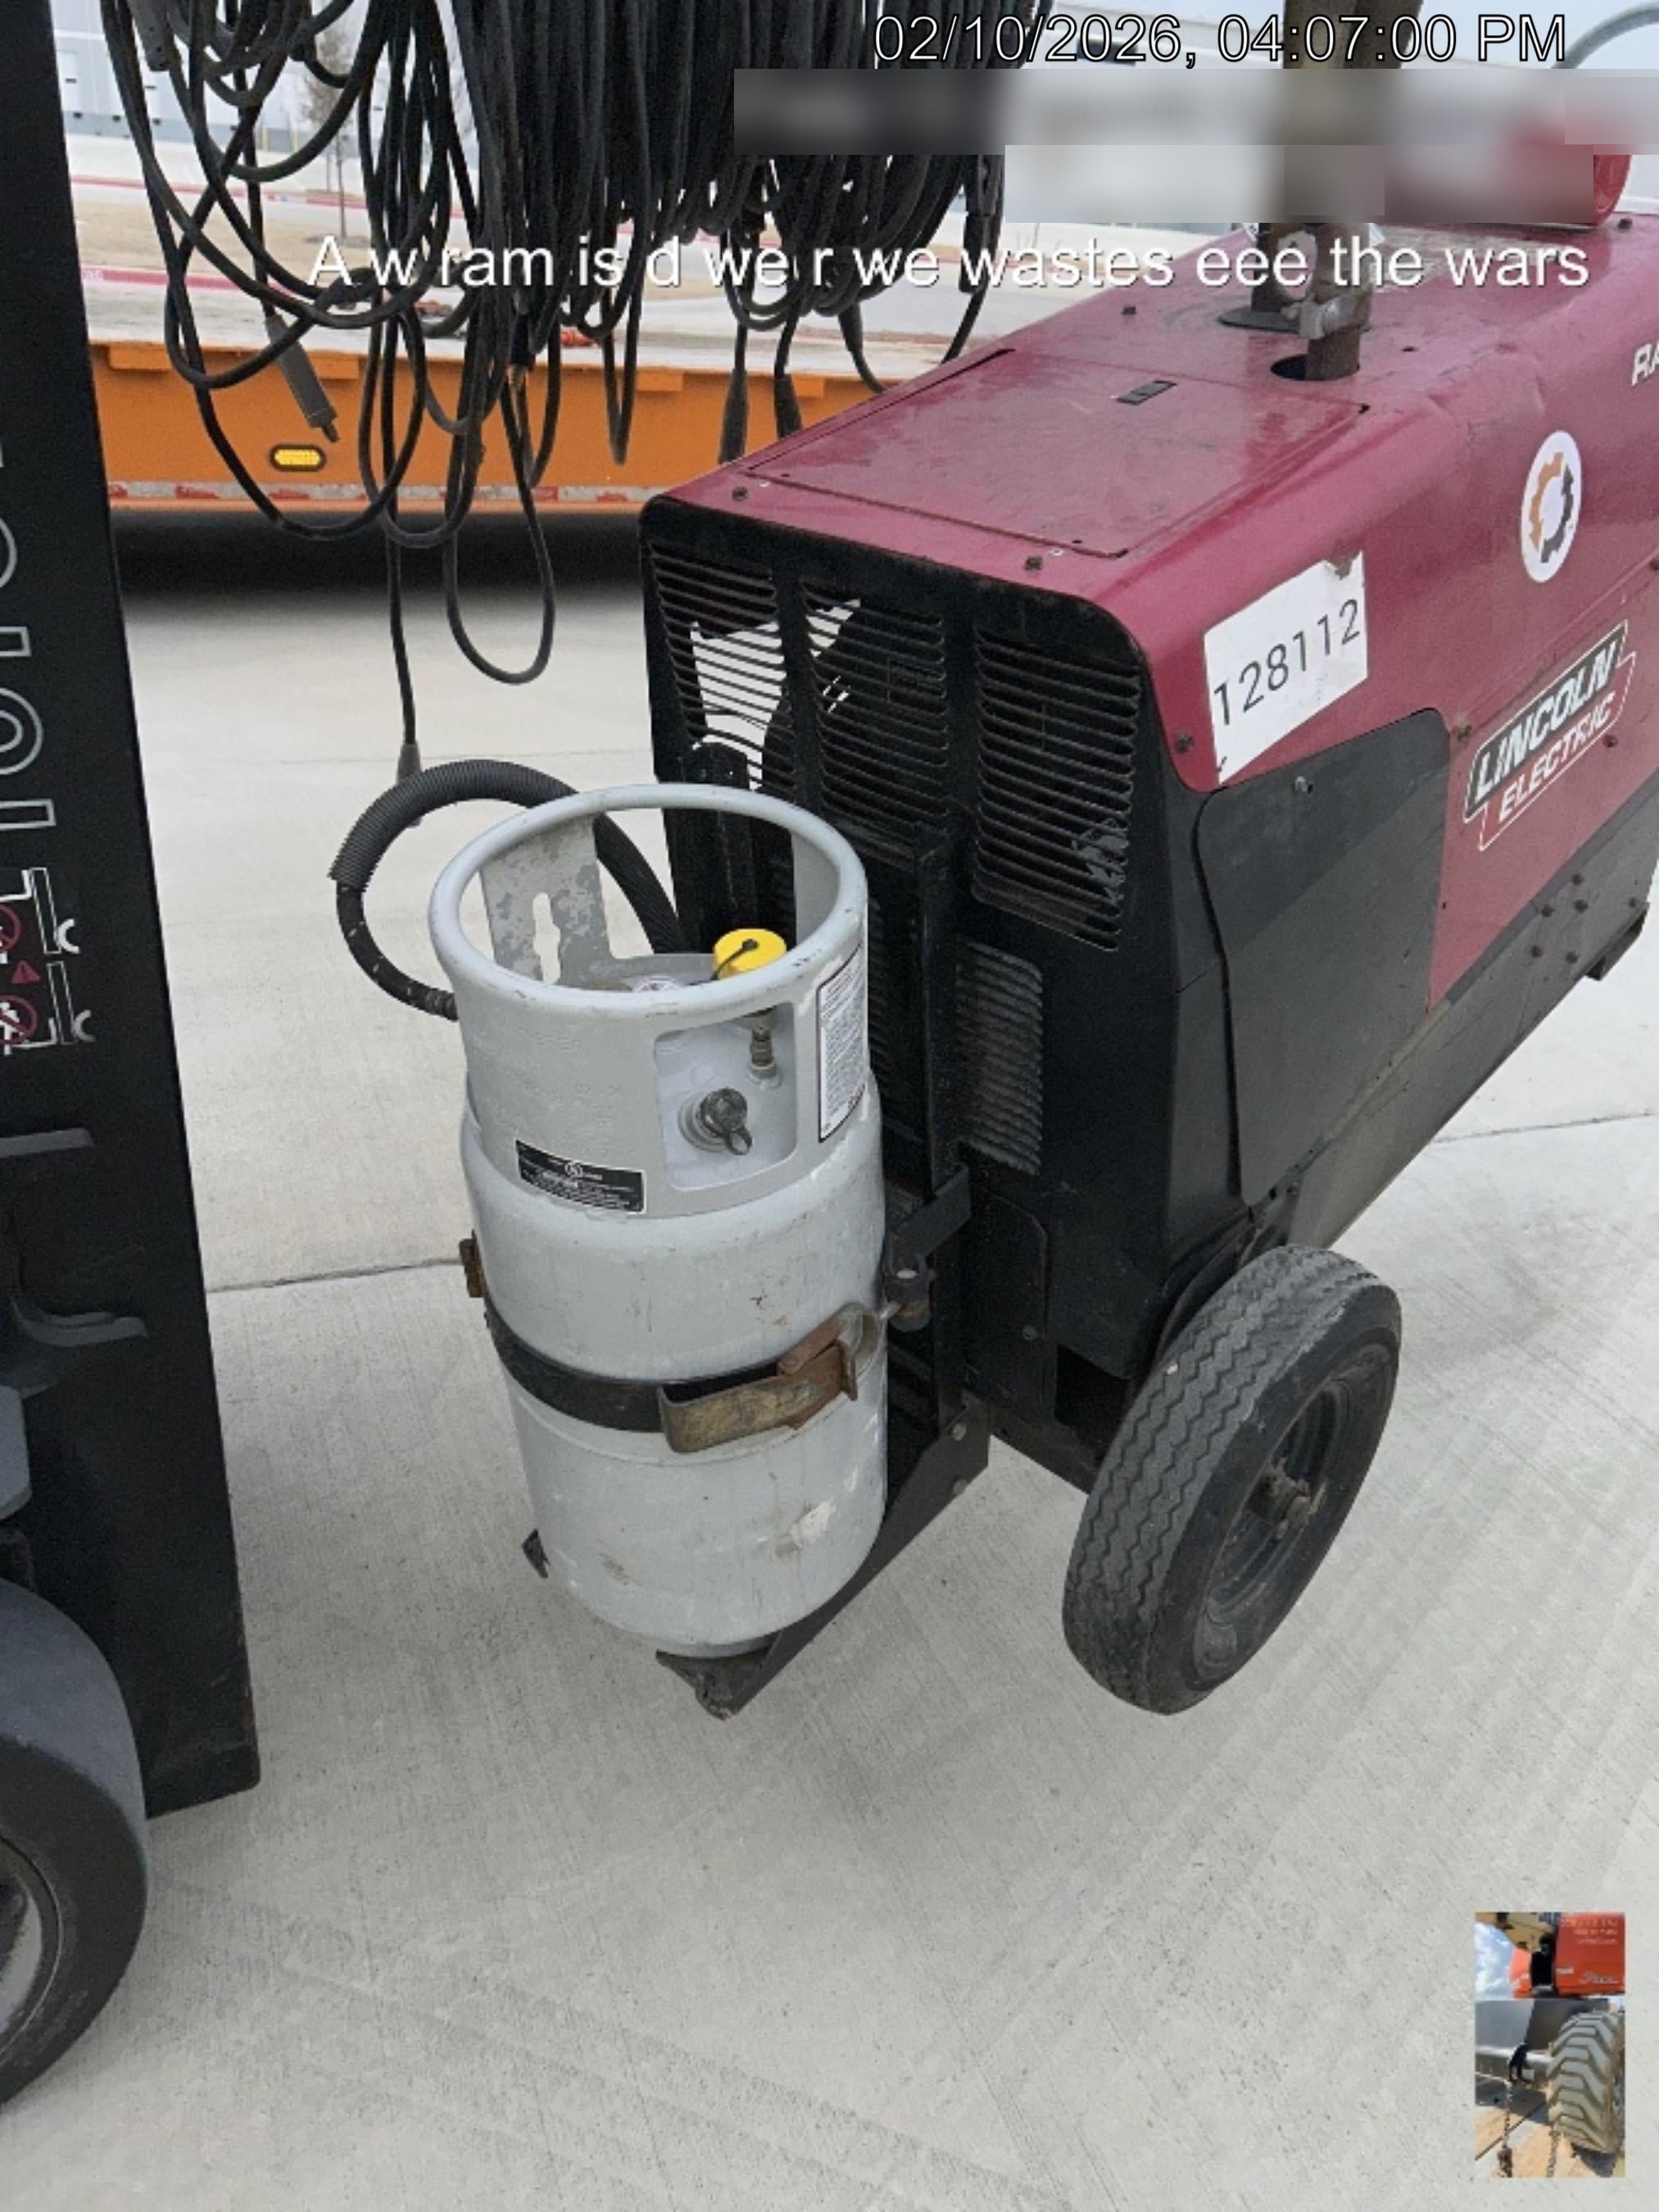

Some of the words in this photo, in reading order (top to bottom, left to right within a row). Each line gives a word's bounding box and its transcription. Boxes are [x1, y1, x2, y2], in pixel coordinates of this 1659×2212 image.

[1214, 599, 1360, 726] 128112
[1475, 640, 1617, 801] LINCOLN
[1499, 691, 1615, 822] ELECTRIC
